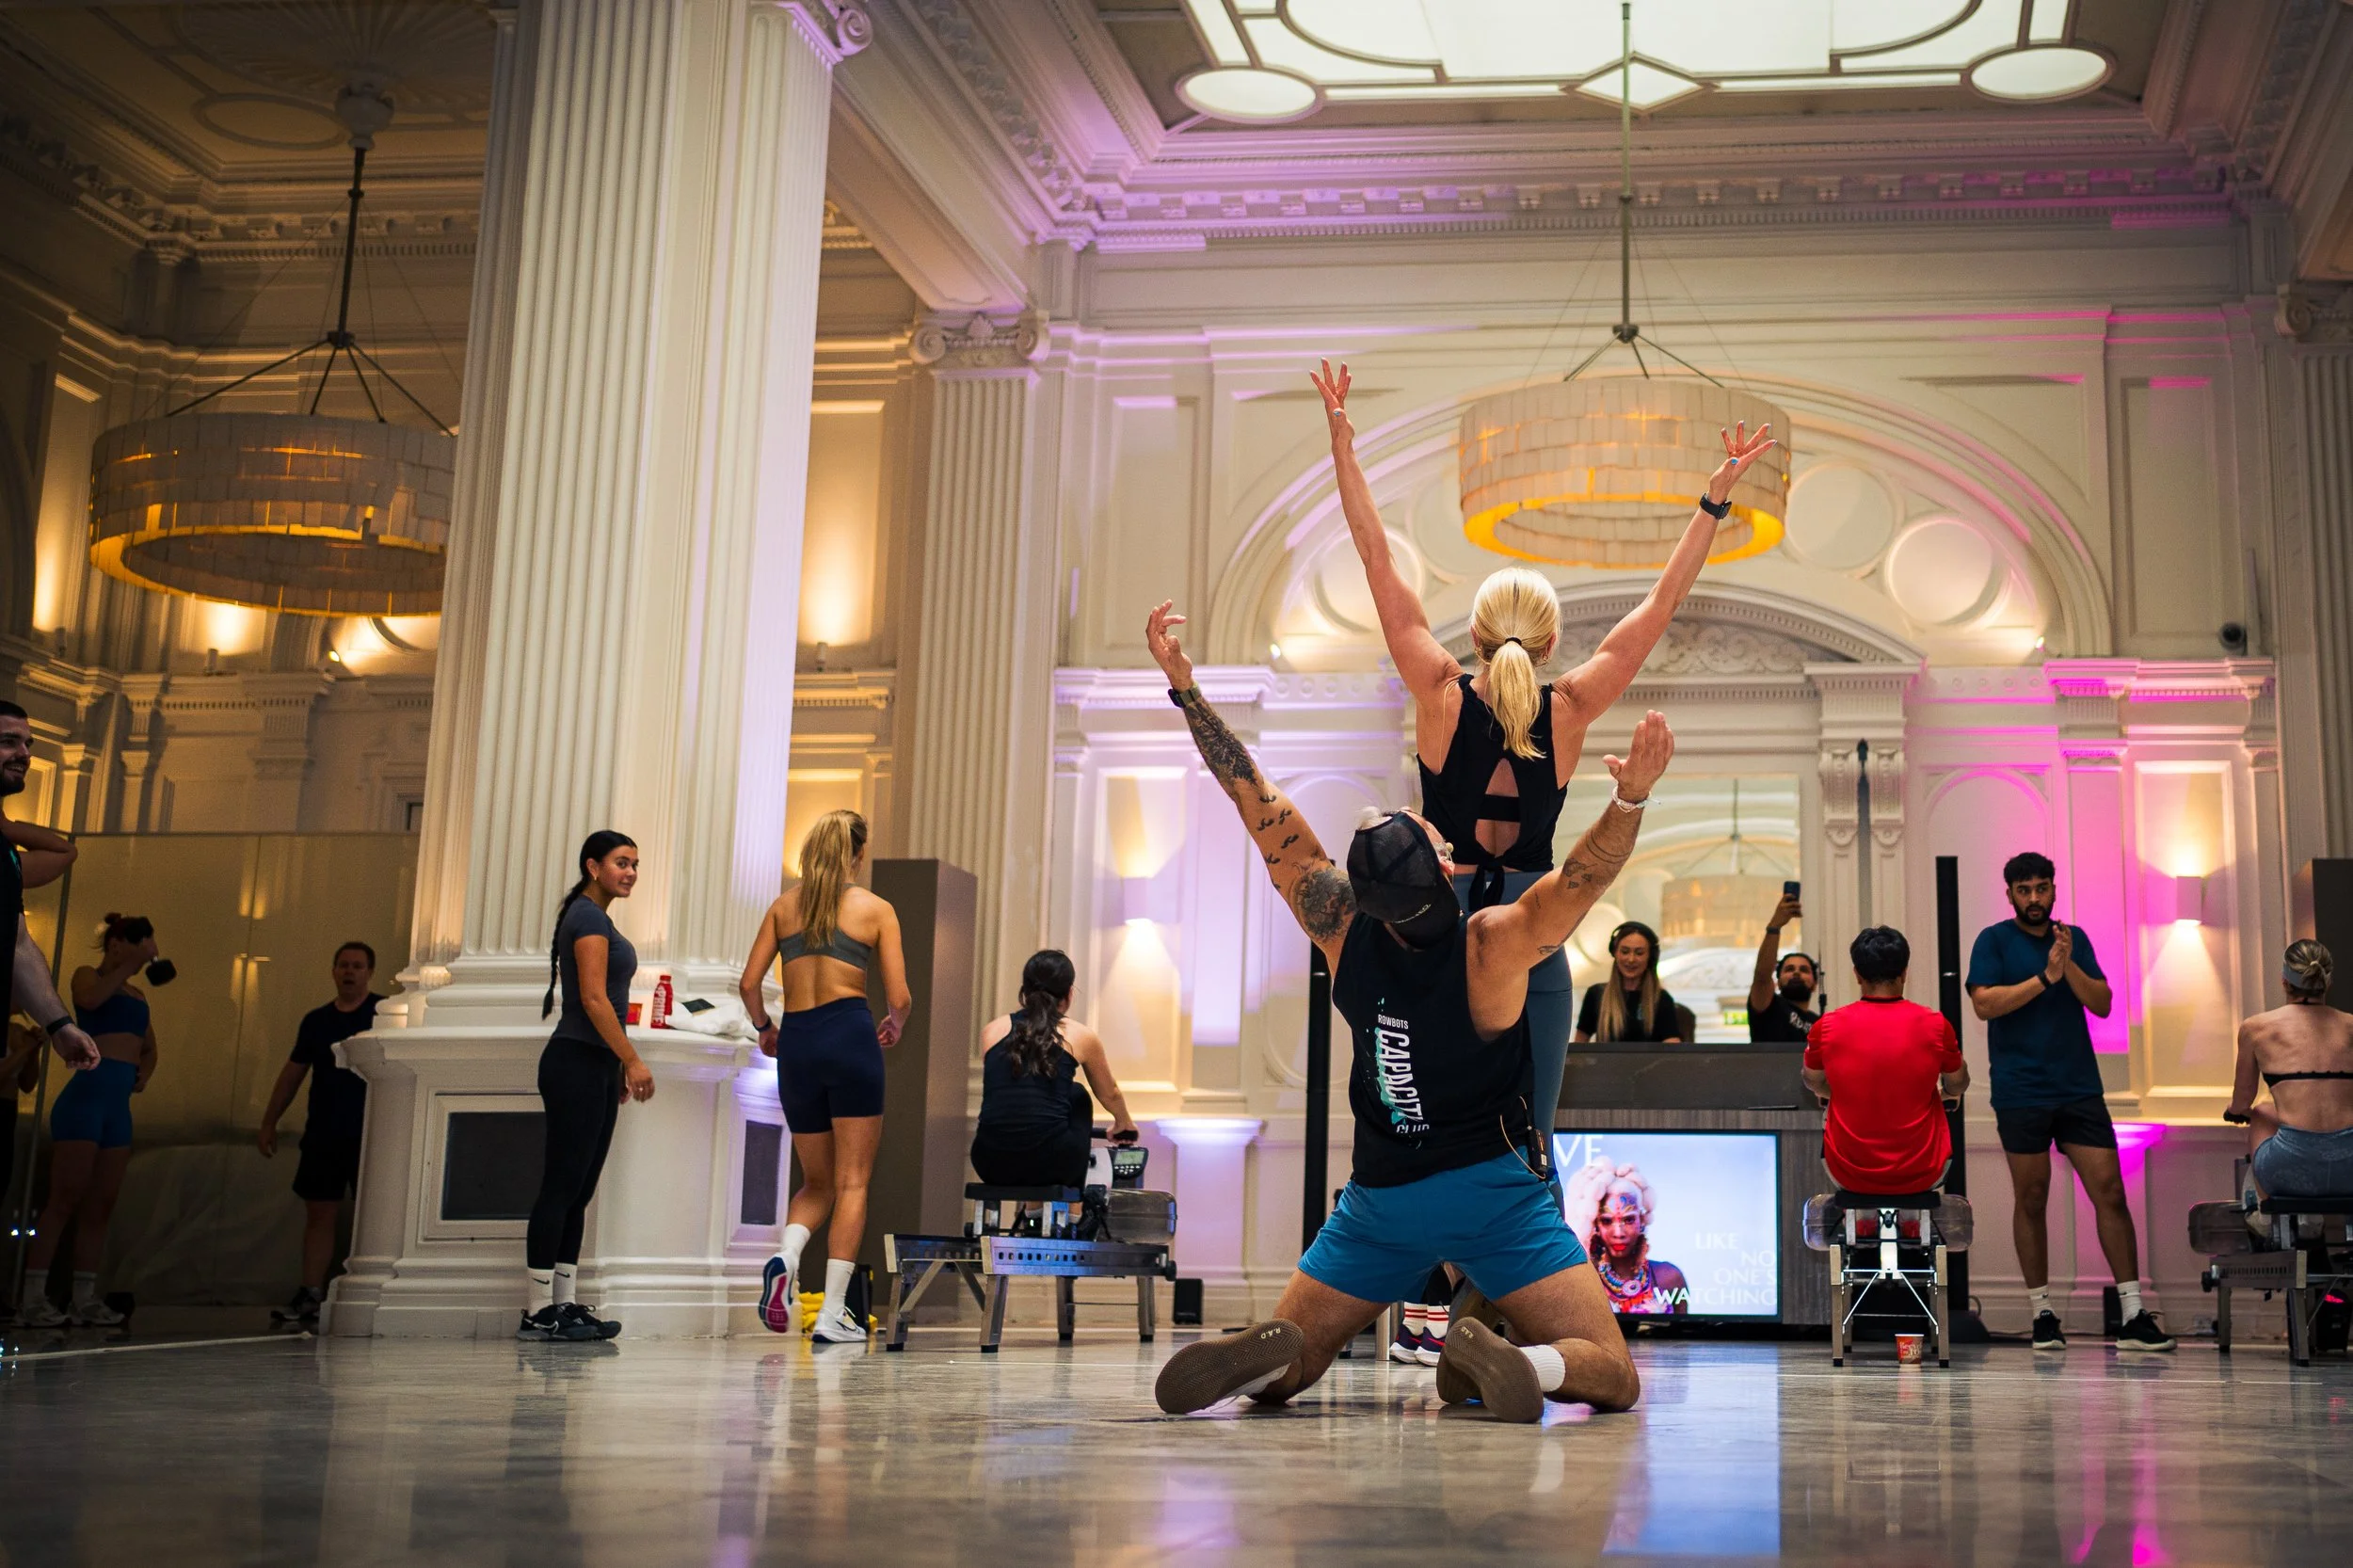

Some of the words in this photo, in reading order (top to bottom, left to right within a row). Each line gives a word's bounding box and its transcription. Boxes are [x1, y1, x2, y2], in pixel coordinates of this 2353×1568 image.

[1378, 1014, 1409, 1030] ROWBOTS
[1553, 1134, 1604, 1168] VE
[1695, 1231, 1738, 1250] LIKE
[1741, 1249, 1775, 1267] NO
[1653, 1287, 1775, 1306] WATCHING
